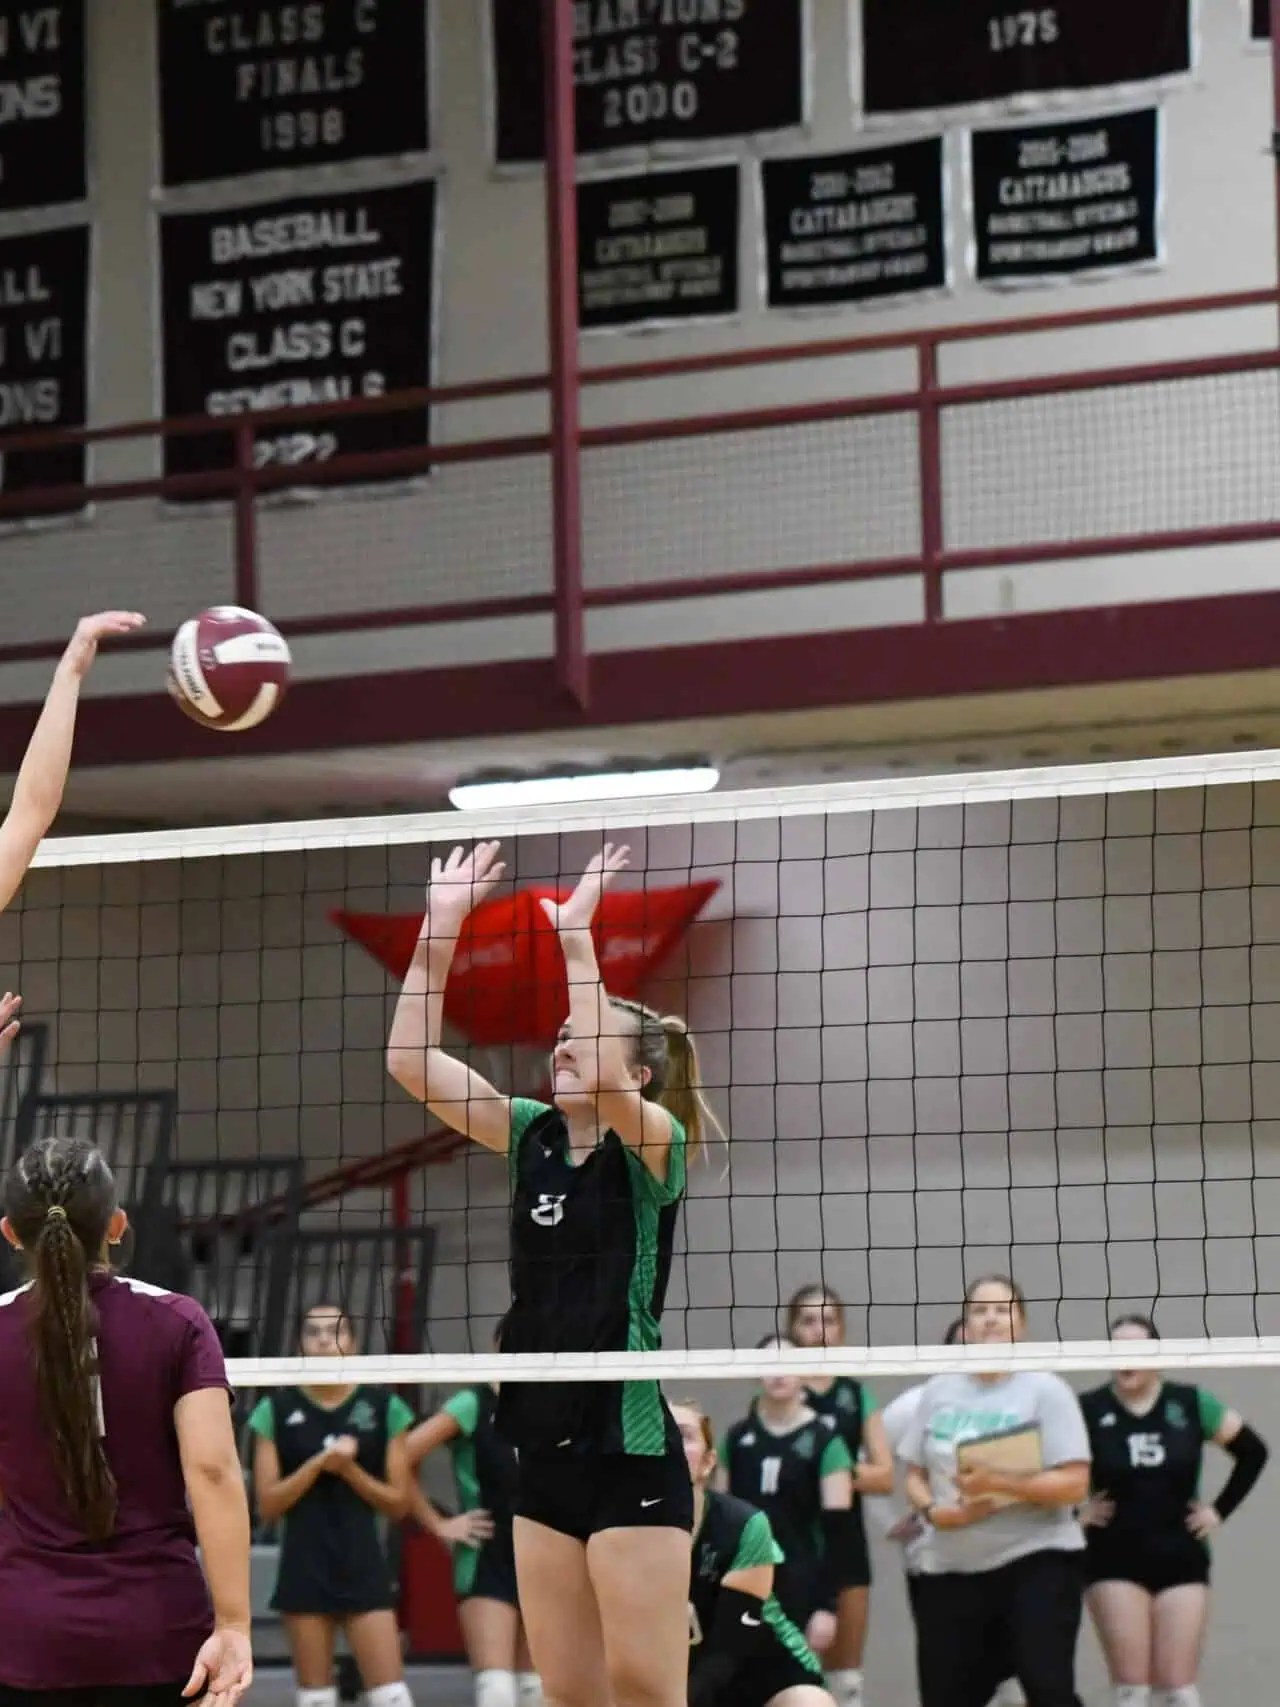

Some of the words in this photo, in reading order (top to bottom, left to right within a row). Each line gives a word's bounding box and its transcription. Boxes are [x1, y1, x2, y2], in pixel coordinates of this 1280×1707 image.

[20, 8, 61, 53] VI
[205, 4, 325, 54] CLASS
[235, 46, 364, 101] FINALS
[575, 35, 658, 84] LASS
[679, 28, 738, 71] C-2
[604, 81, 698, 128] 2000
[211, 207, 381, 264] BASEBALL
[189, 280, 242, 320] NEW
[250, 268, 318, 312] YORK
[323, 257, 403, 304] STATE
[24, 316, 62, 361] VI
[227, 320, 332, 372] CLASS
[340, 318, 366, 358] C
[1127, 1431, 1168, 1468] 15
